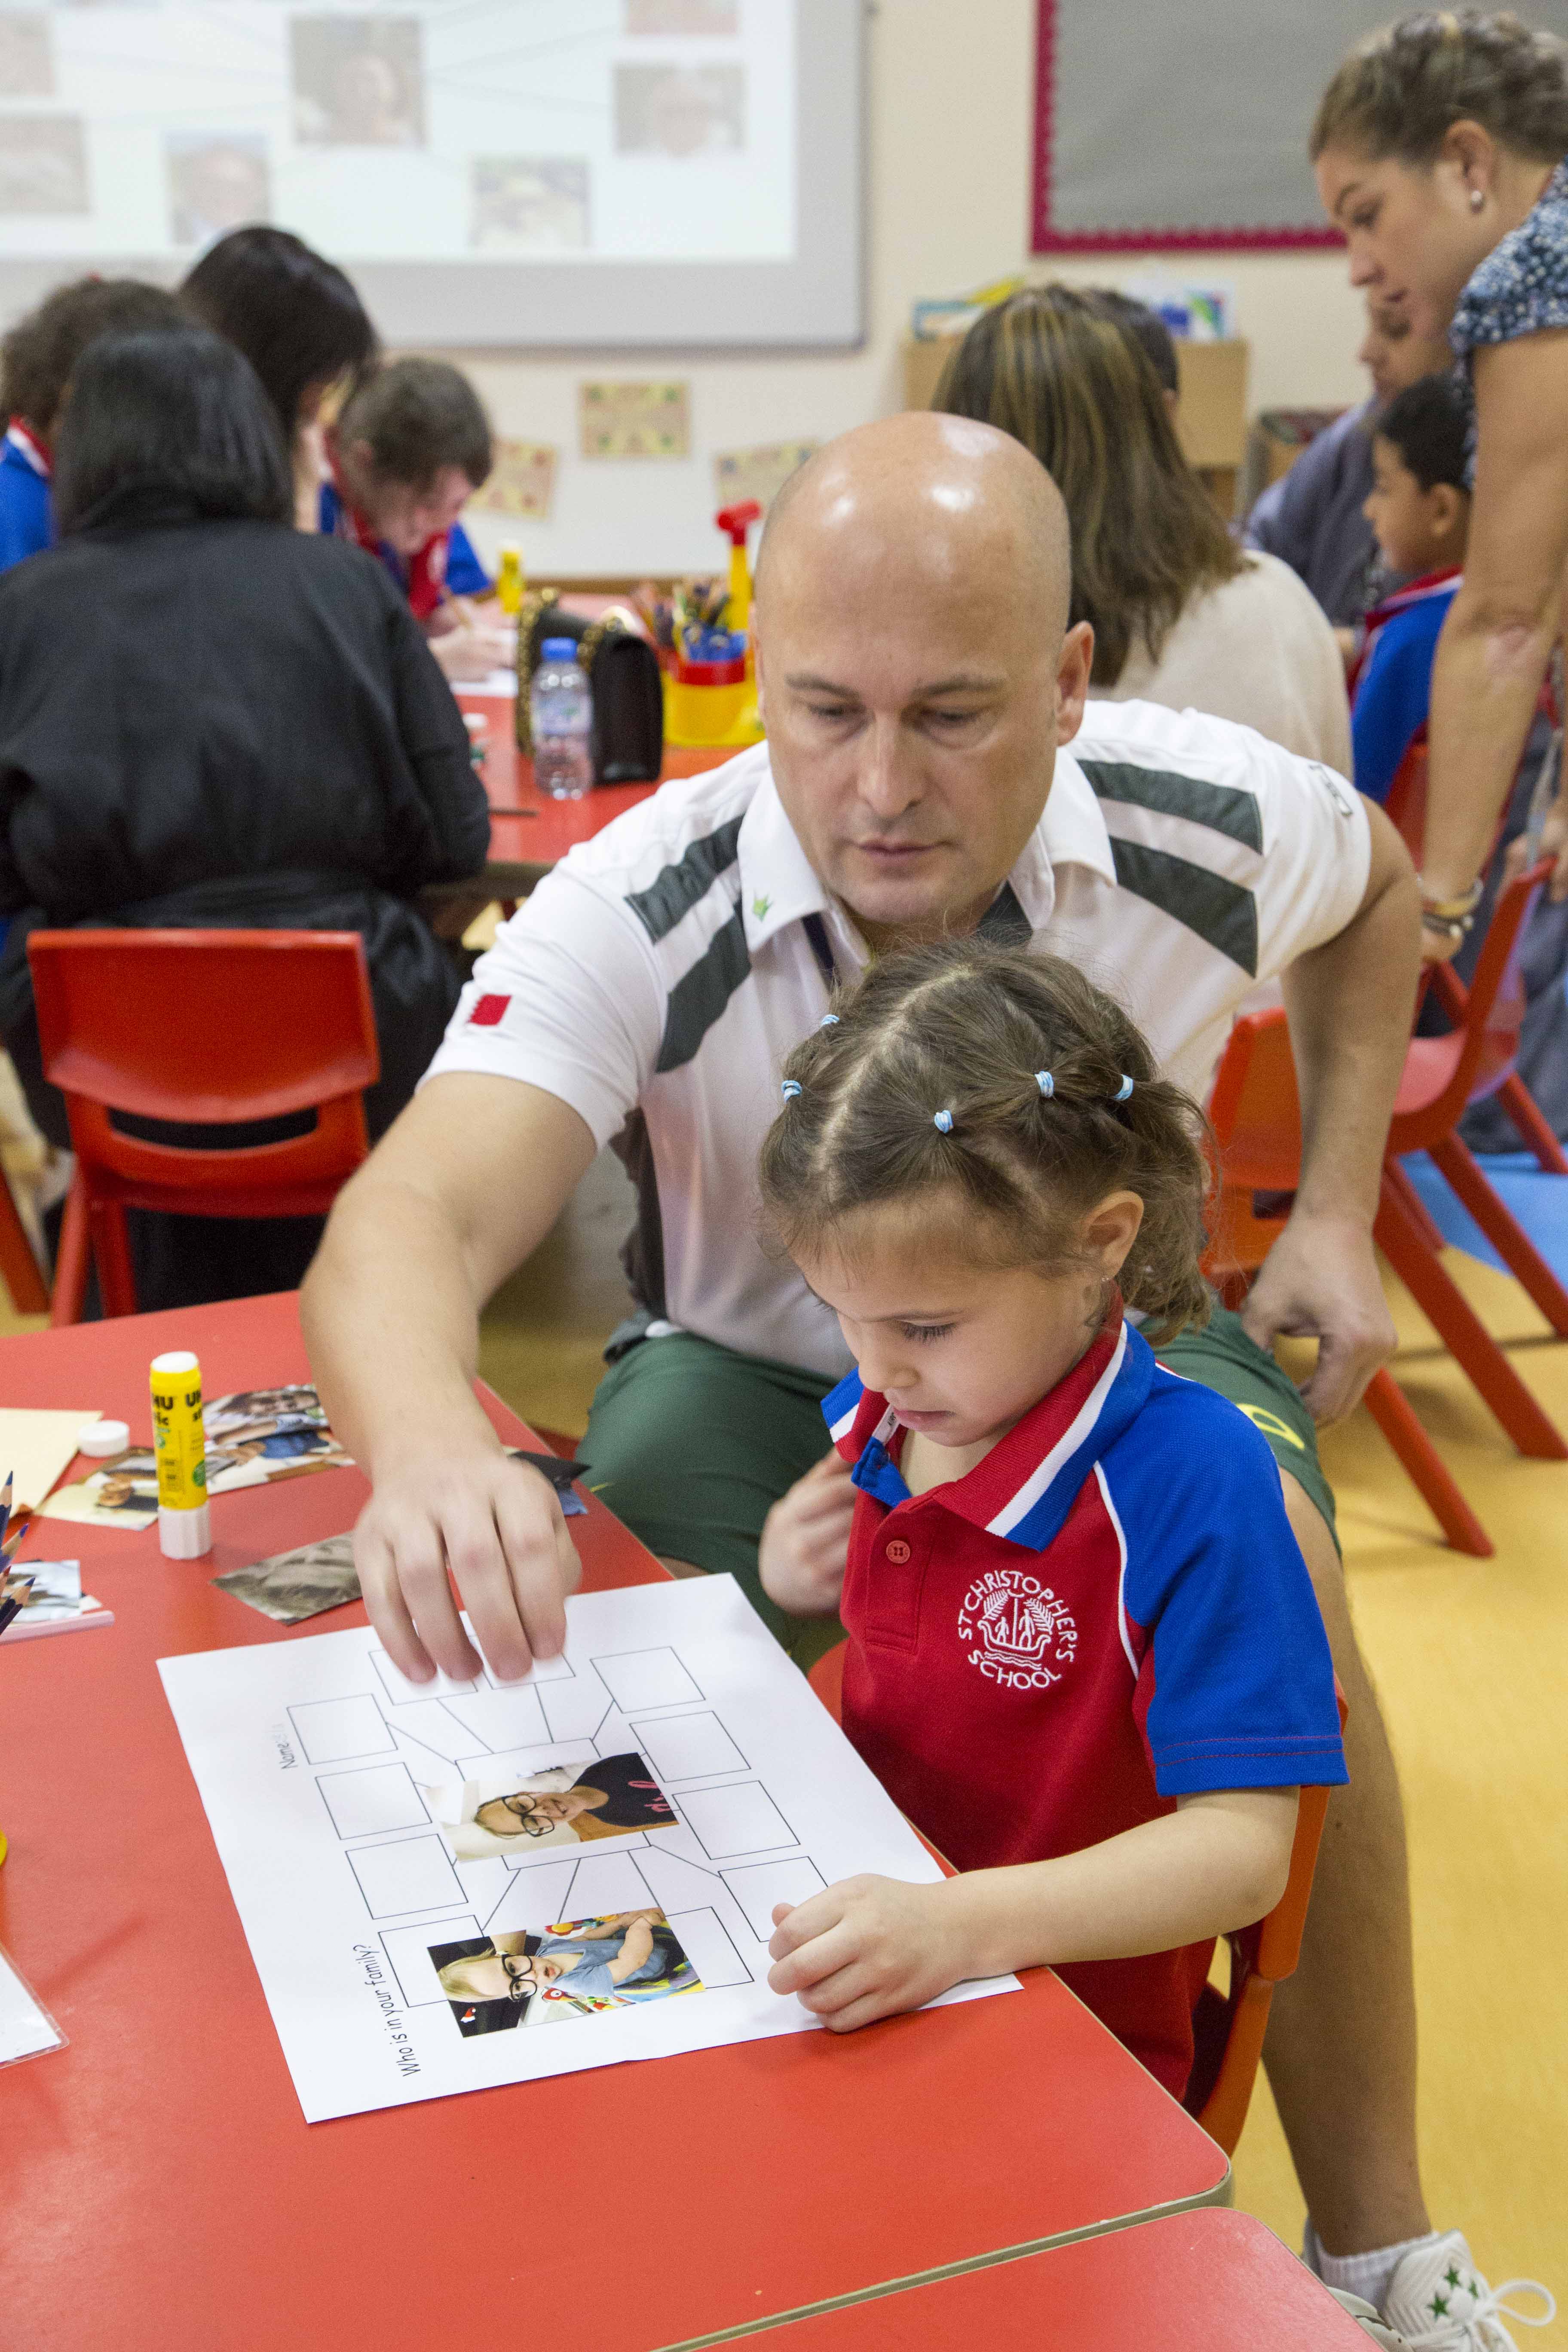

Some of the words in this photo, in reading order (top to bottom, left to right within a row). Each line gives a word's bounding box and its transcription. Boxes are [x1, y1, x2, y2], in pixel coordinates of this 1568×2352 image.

[958, 1608, 972, 1640] ST
[964, 1570, 1078, 1663] CHRISTOPHER'S
[968, 1649, 1063, 1690] SCHOOL
[352, 1944, 386, 1986] family?
[374, 1990, 404, 2017] your
[384, 2018, 403, 2031] in
[389, 2033, 408, 2045] is
[395, 2047, 421, 2077] Who
